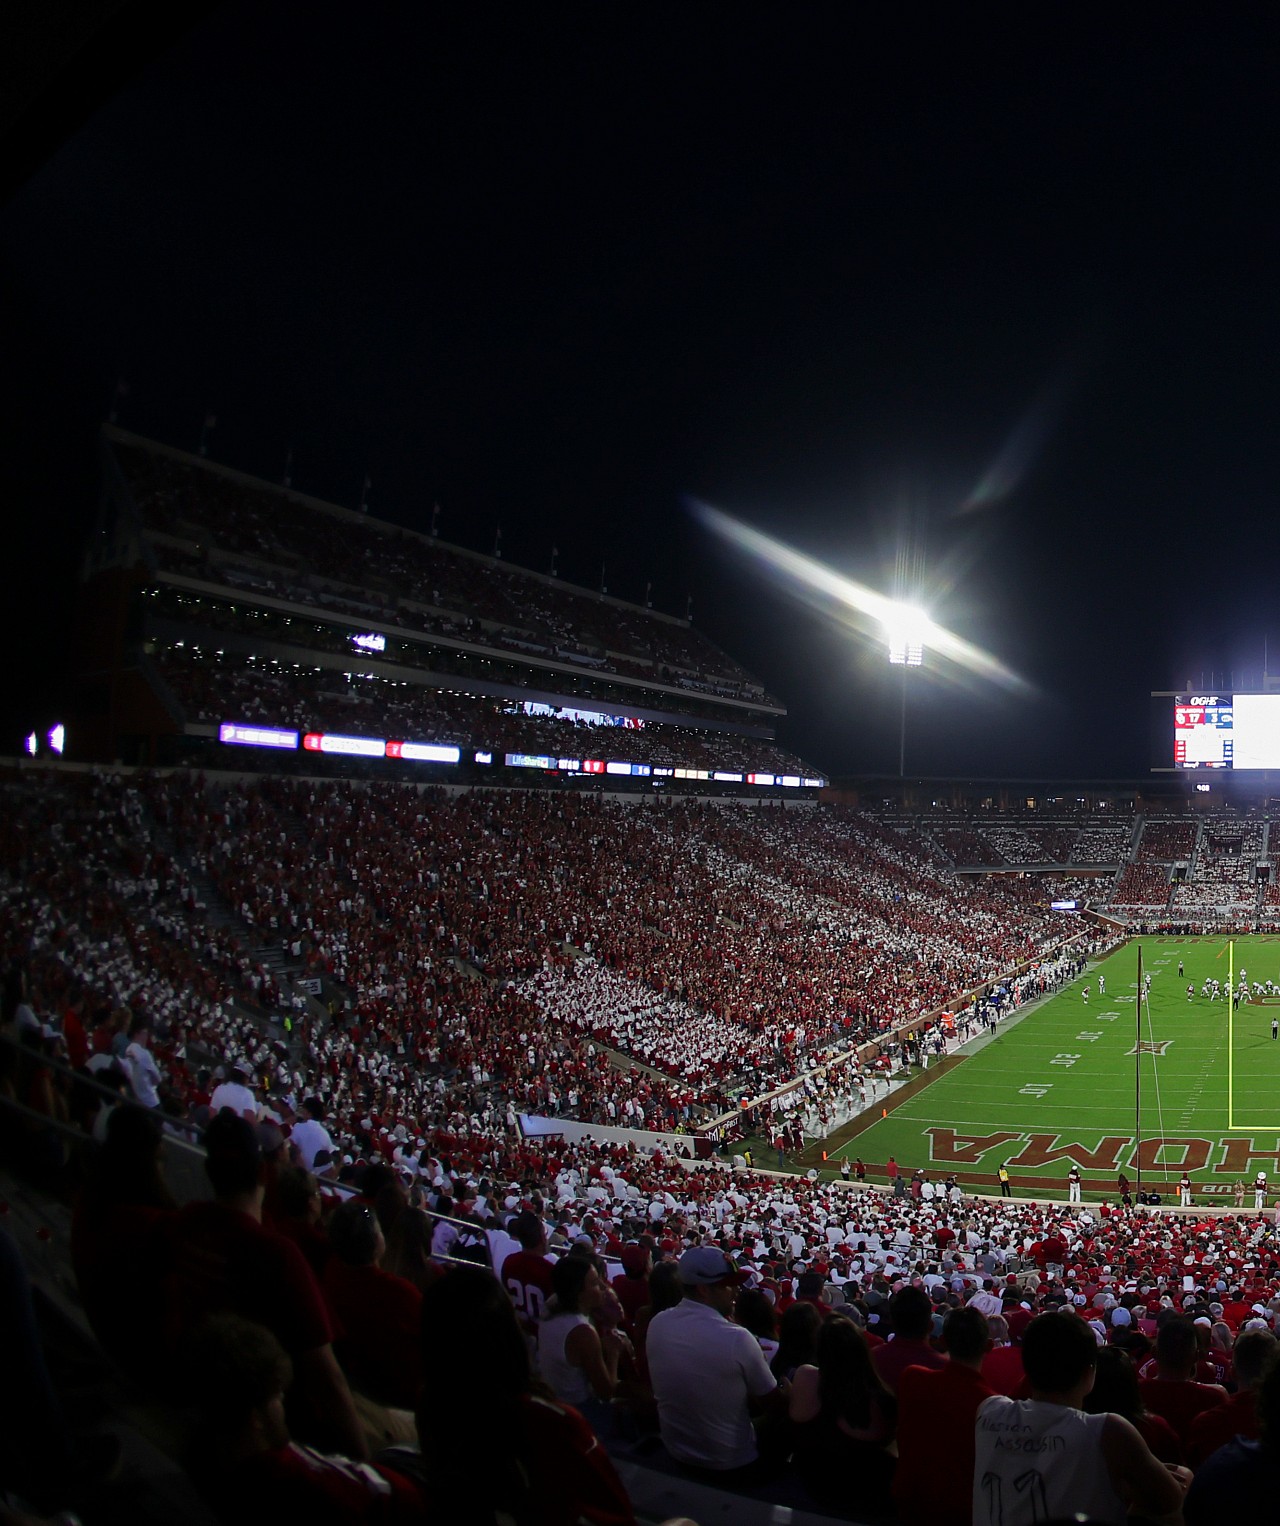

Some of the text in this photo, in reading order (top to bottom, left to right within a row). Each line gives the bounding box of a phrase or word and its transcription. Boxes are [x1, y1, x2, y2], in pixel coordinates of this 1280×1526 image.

[1189, 713, 1200, 723] 17
[1049, 1053, 1082, 1065] 20
[1018, 1083, 1054, 1095] 10
[507, 1278, 545, 1318] 20
